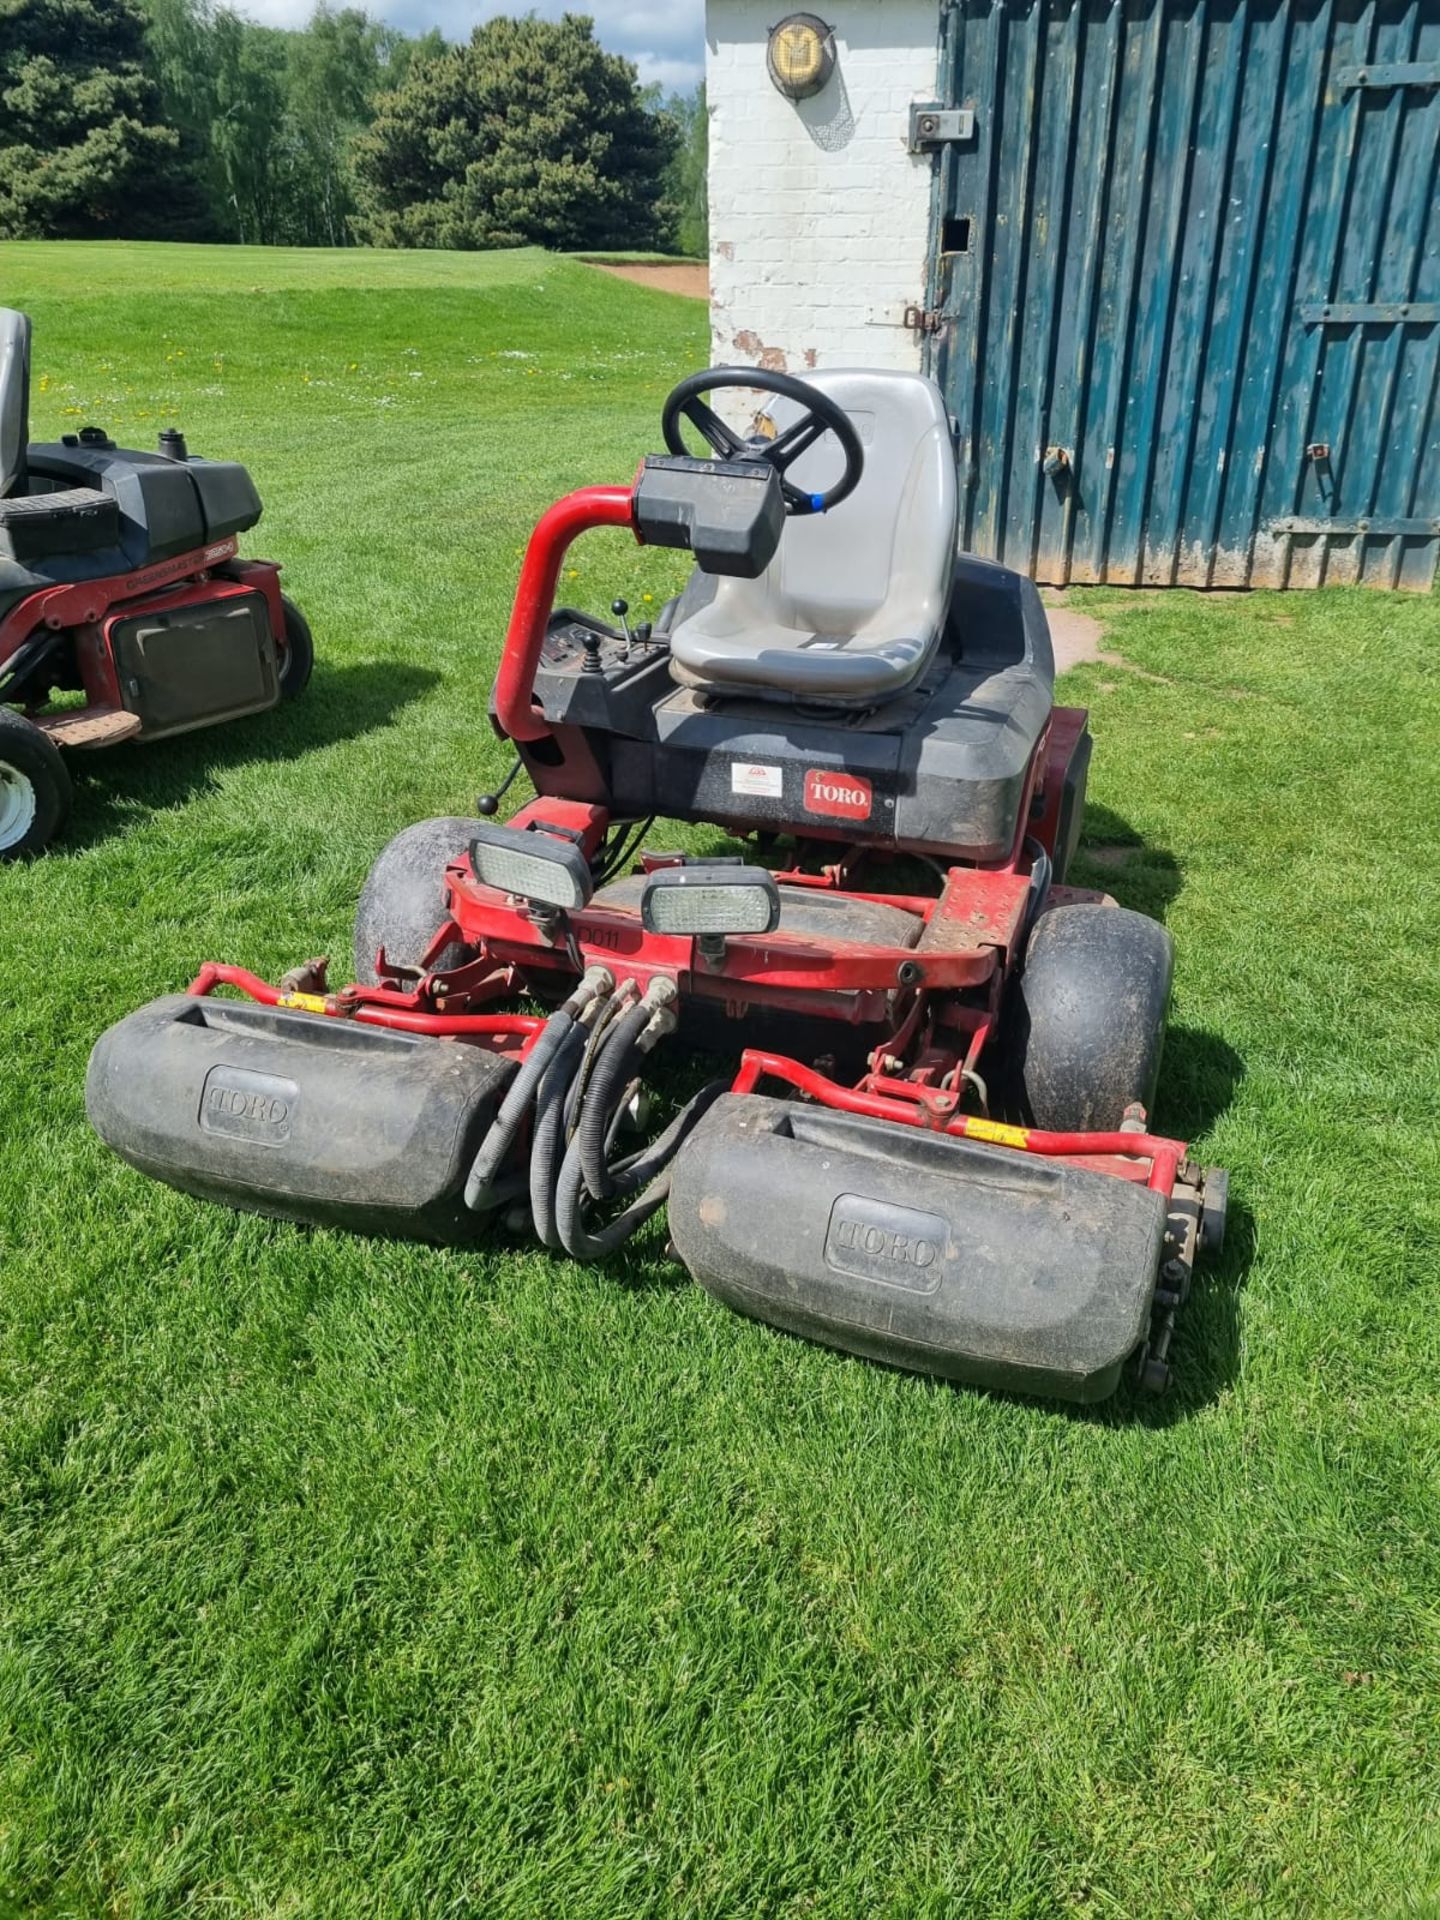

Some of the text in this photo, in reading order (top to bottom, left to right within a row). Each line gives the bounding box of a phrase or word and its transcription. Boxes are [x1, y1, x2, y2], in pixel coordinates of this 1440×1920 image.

[810, 783, 867, 806] TORO
[209, 1087, 288, 1124] TORO
[838, 1220, 936, 1268] TORO
